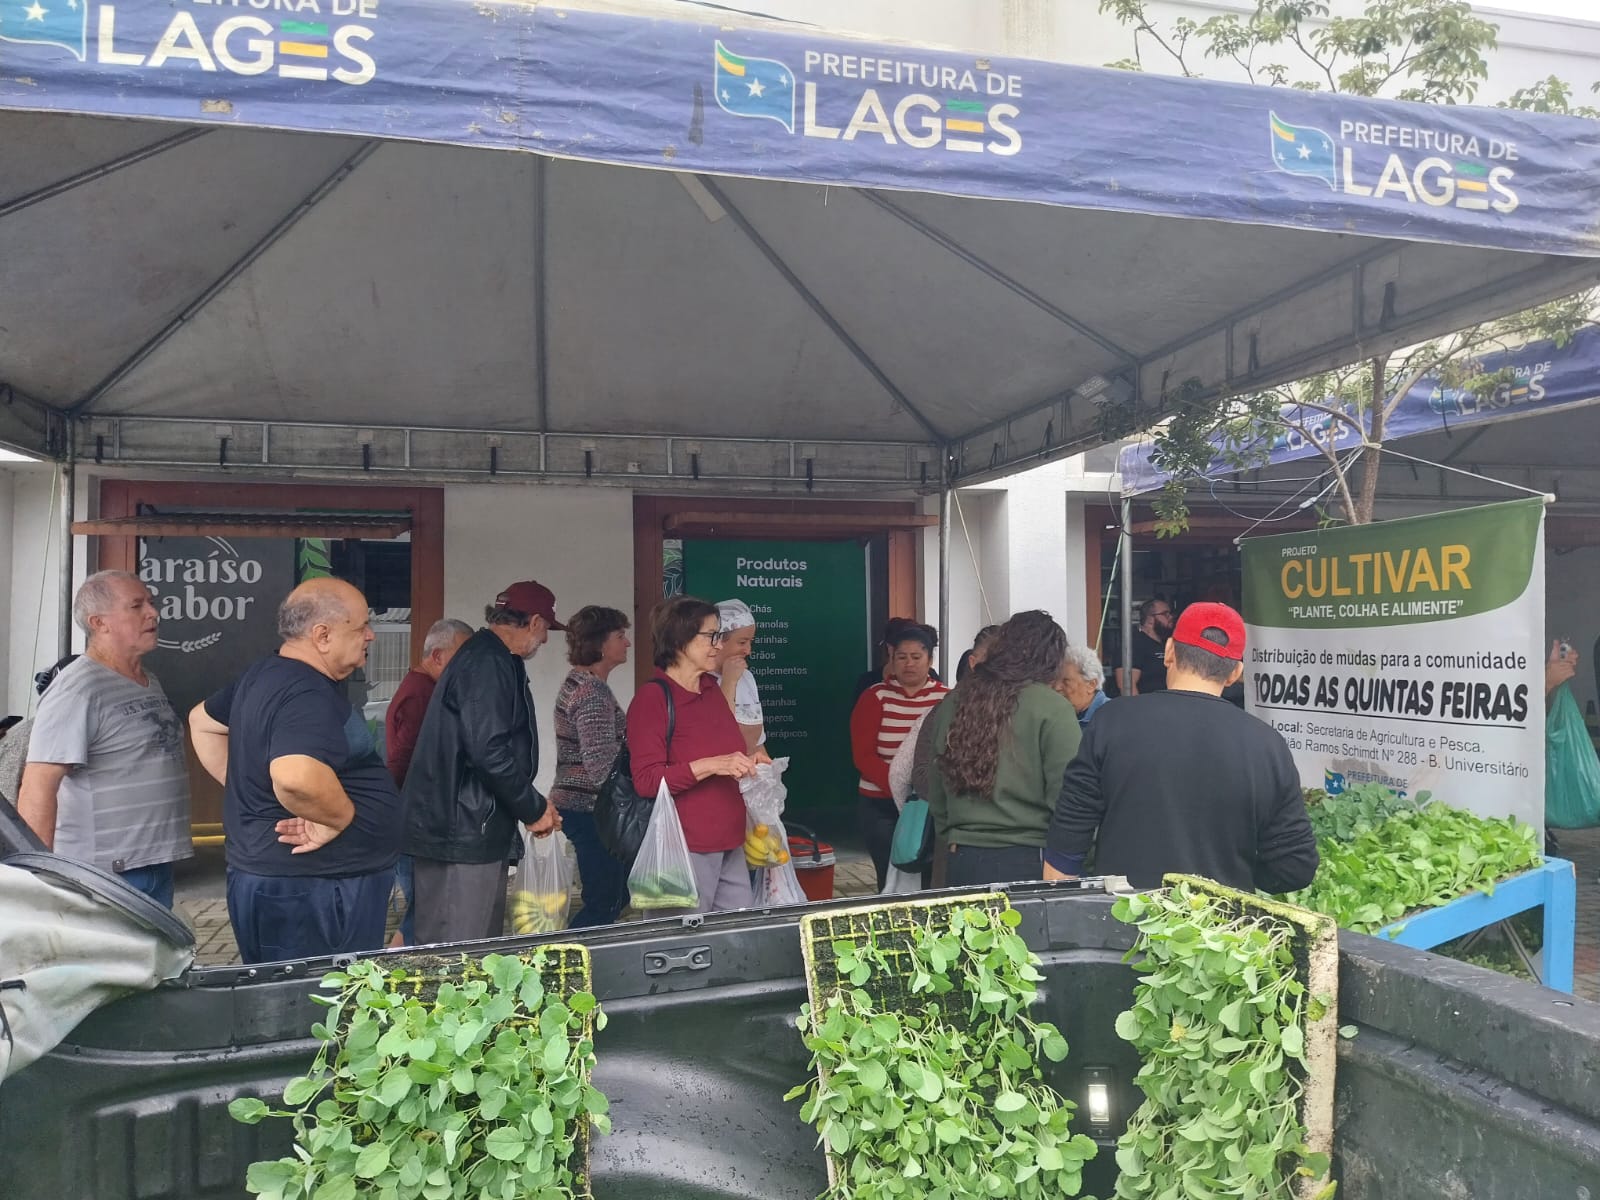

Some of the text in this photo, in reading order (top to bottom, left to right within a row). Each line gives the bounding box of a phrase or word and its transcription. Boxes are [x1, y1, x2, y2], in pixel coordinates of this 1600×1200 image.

[98, 5, 376, 85] LAGES
[804, 50, 1023, 98] PREFEITURA DE
[804, 81, 1023, 157] LAGES
[1340, 119, 1519, 161] PREFEITURA DE
[1342, 146, 1519, 214] LAGES
[1534, 360, 1552, 375] DE
[736, 557, 808, 571] Produtos
[1281, 545, 1317, 558] PROJETO
[736, 574, 804, 588] Naturais
[1281, 544, 1472, 599] CULTIVAR
[756, 619, 789, 629] ranolas
[1338, 602, 1379, 618] COLHA
[1381, 602, 1389, 616] E
[1252, 647, 1527, 670] Distribuição de mudas para a comunidade
[1254, 672, 1529, 722] TODAS AS QUINTAS FEIRAS
[1271, 719, 1485, 754] Local: Secretaria de Agricultura e Pesca.
[1305, 739, 1340, 756] Ramos
[1342, 743, 1379, 761] Schimdt
[1397, 750, 1417, 766] 288
[1445, 754, 1529, 779] Universitário
[1396, 778, 1408, 789] DE
